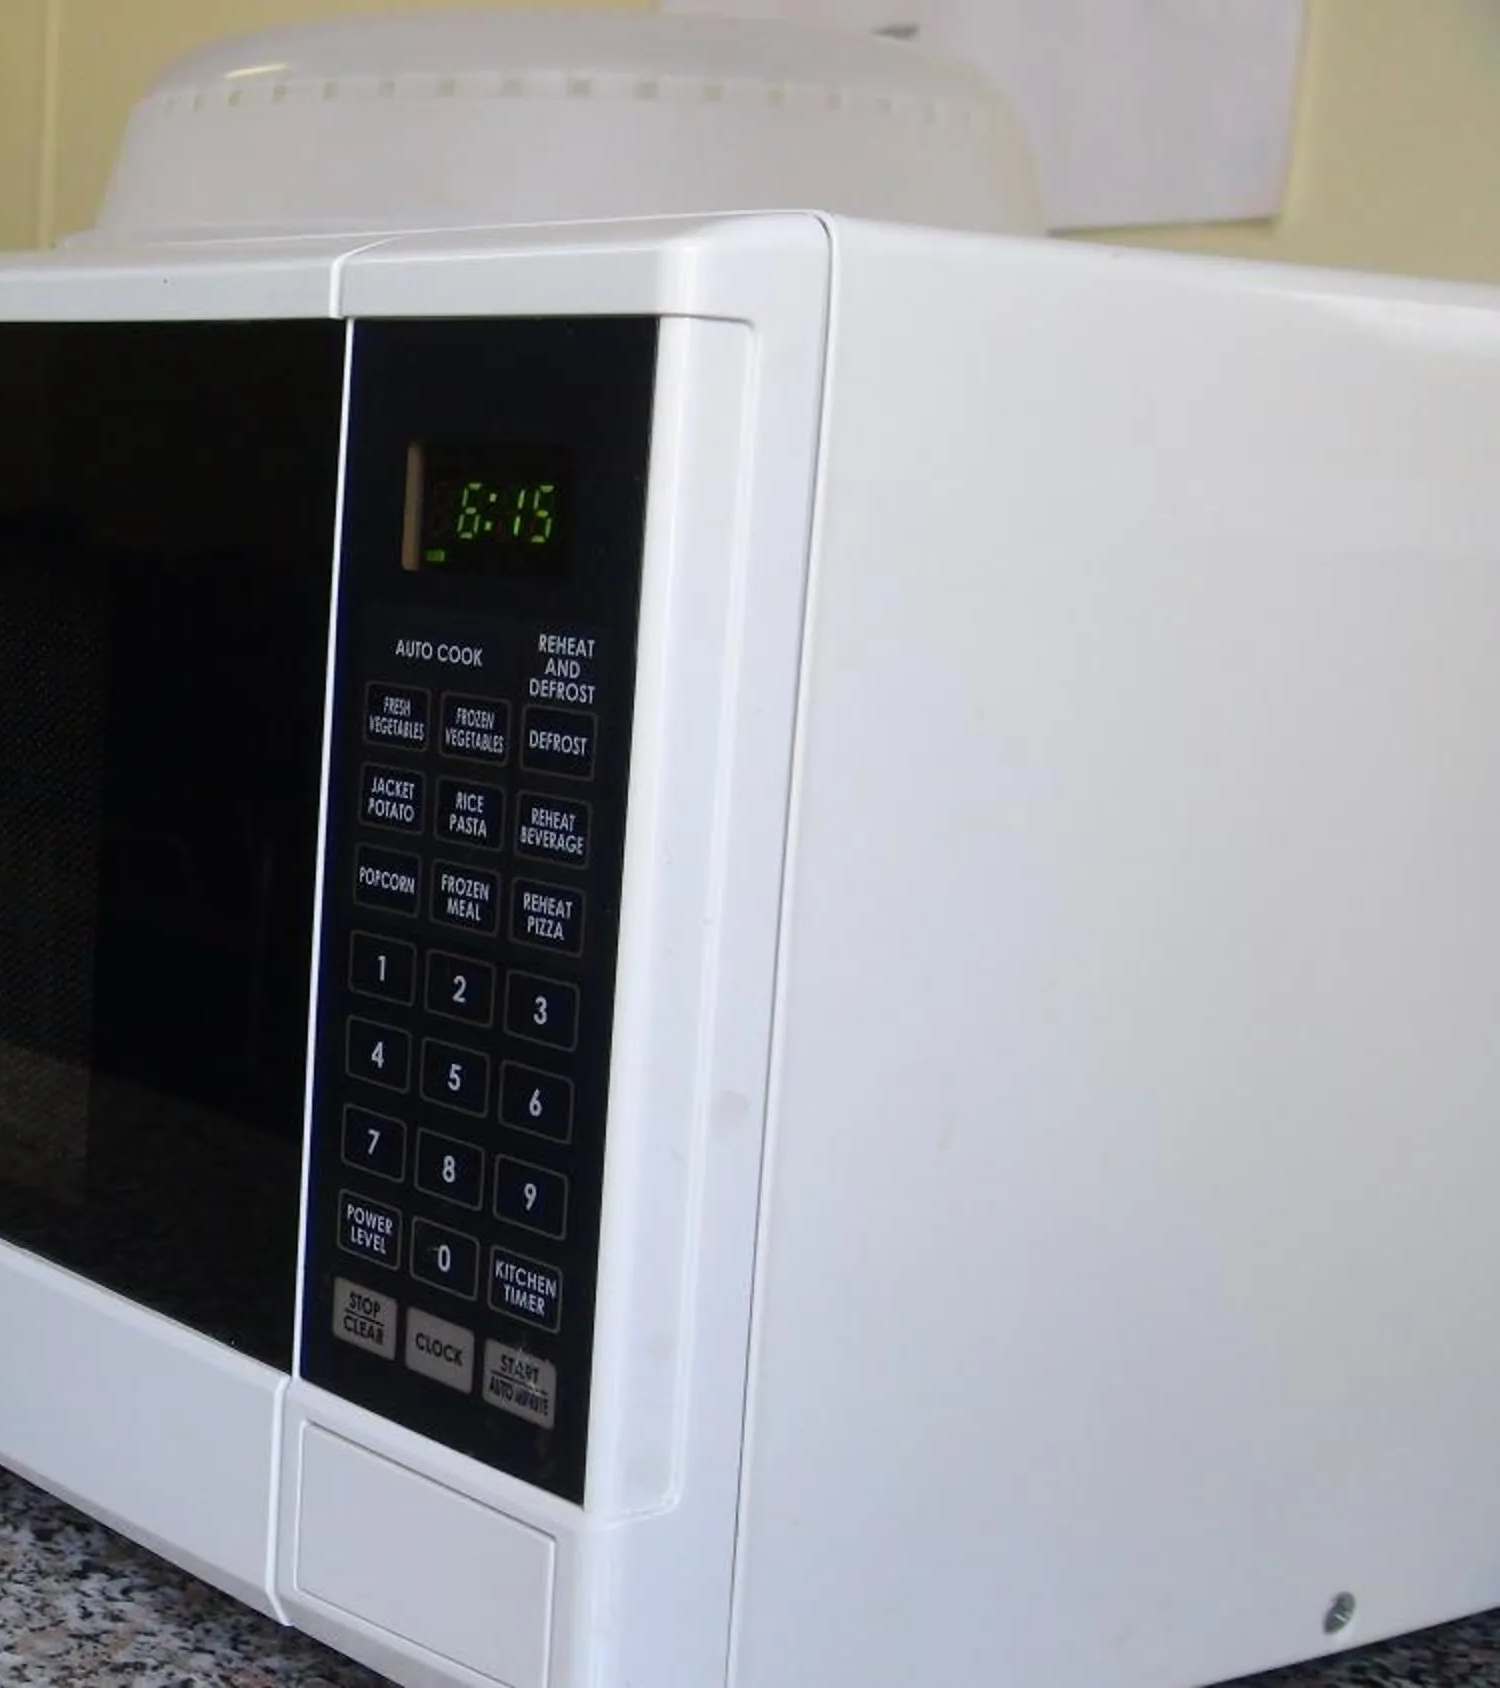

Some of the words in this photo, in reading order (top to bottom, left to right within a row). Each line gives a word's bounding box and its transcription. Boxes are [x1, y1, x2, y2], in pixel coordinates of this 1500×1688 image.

[457, 482, 554, 543] 6:15
[395, 639, 433, 661] AUTO
[437, 644, 483, 667] COOK
[538, 633, 595, 658] REHEAT
[544, 658, 581, 679] AND
[529, 678, 595, 704] DEFROST
[383, 696, 411, 716] FRESH
[455, 707, 495, 730] FROZEN
[369, 714, 425, 742] VEGETABLES
[445, 728, 504, 754] VEGETABLES
[529, 729, 588, 757] DEFROST
[371, 776, 415, 800] JACKET
[367, 797, 415, 823] POTATO
[455, 791, 484, 814] RICE
[449, 813, 487, 838] PASTA
[531, 807, 576, 832] REHEAT
[520, 826, 585, 856] BEVERAGE
[359, 866, 415, 895] POPCORN
[441, 873, 490, 901] FROZEN
[447, 897, 481, 921] MEAL
[523, 892, 573, 919] REHEAT
[527, 915, 564, 941] PIZZA
[378, 955, 387, 981] 1
[452, 974, 468, 1003] 2
[533, 996, 548, 1025] 3
[370, 1041, 385, 1069] 4
[448, 1063, 462, 1091] 5
[529, 1089, 543, 1118] 6
[367, 1129, 380, 1156] 7
[442, 1155, 456, 1184] 8
[524, 1182, 537, 1212] 9
[346, 1203, 393, 1235] POWER
[350, 1225, 387, 1256] LEVEL
[438, 1244, 451, 1272] 0
[495, 1259, 557, 1298] KITCHEN
[349, 1291, 381, 1317] STOP
[503, 1283, 546, 1316] TIMER
[343, 1314, 385, 1346] CLEAR
[415, 1332, 463, 1367] CLOCK
